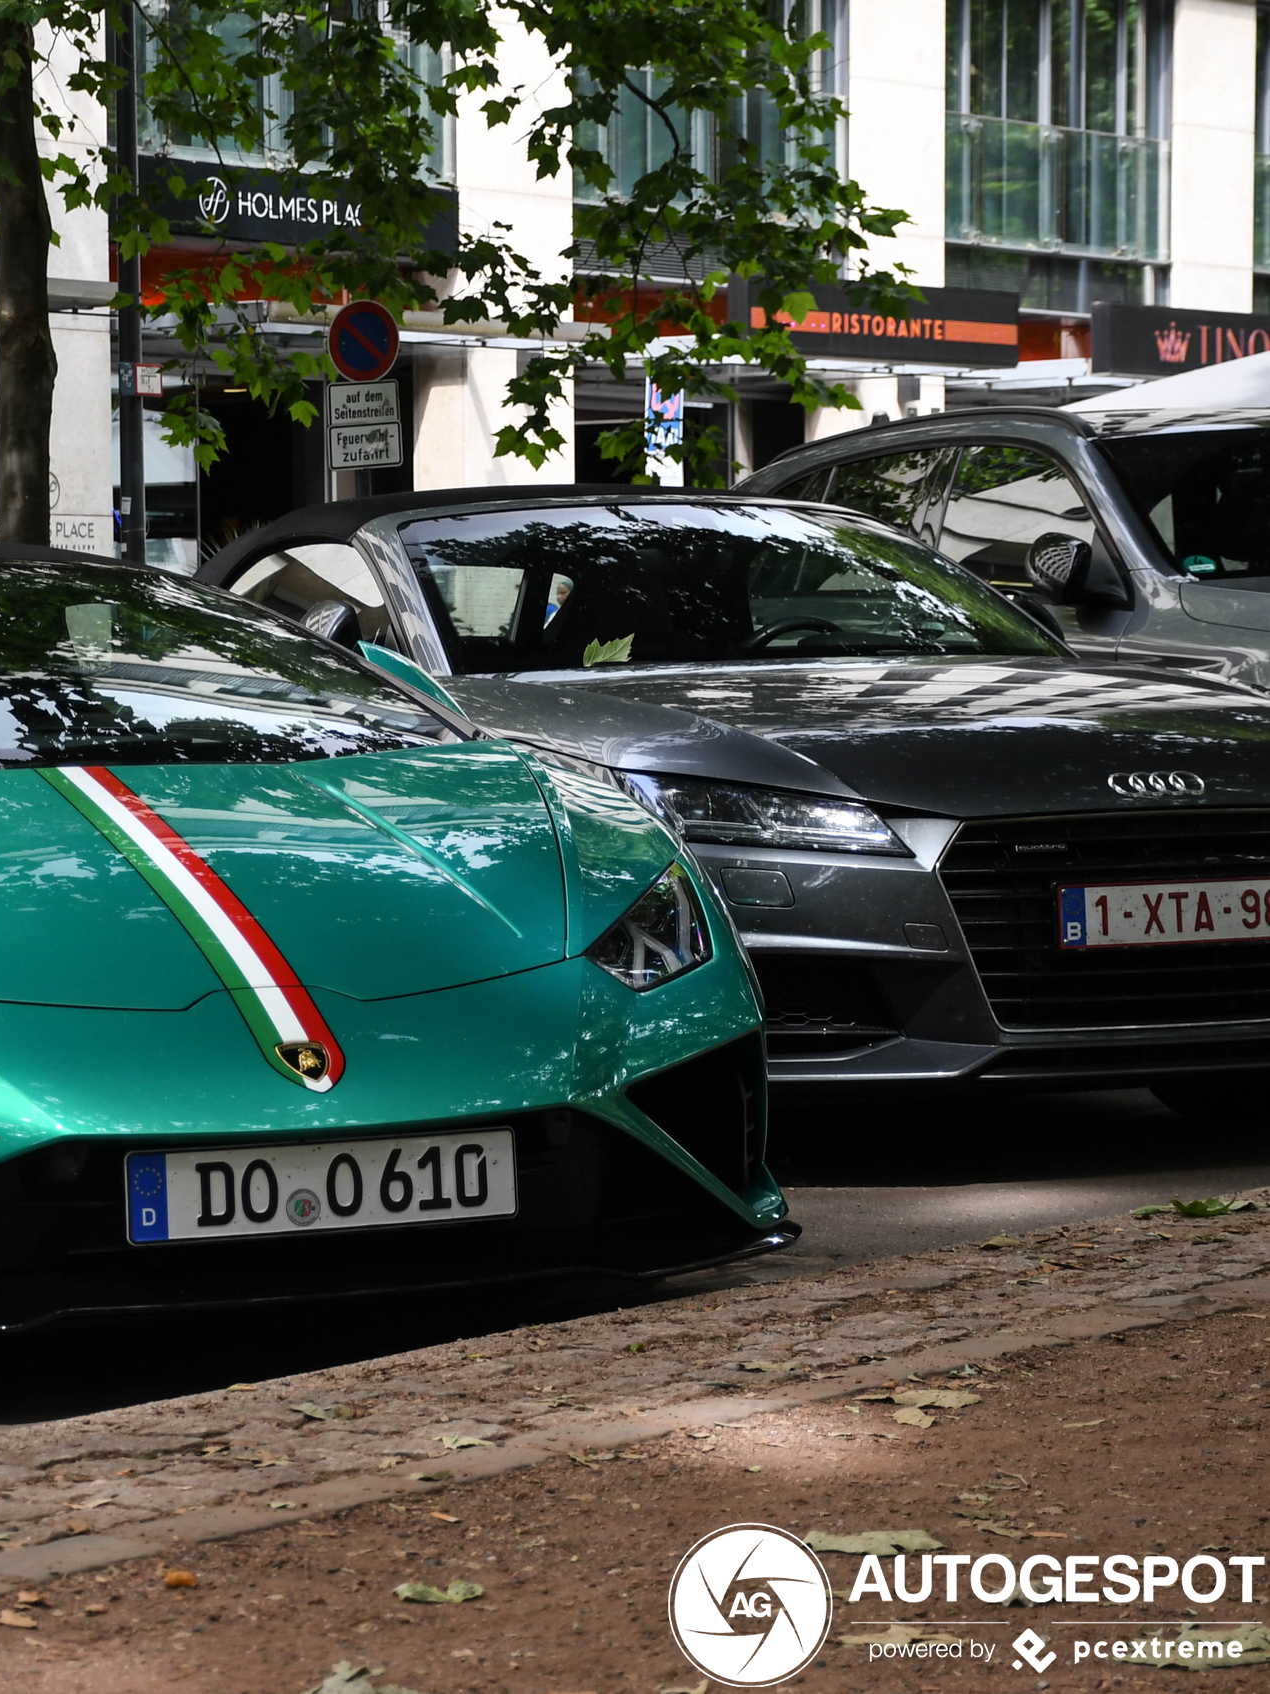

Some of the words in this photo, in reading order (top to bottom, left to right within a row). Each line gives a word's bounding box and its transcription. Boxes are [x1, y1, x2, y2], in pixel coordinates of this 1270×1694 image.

[238, 190, 318, 224] HOLMES
[830, 311, 944, 341] RISTORANTE
[346, 391, 360, 403] auf
[365, 390, 383, 402] dem
[334, 405, 395, 420] Seitenstreifen
[55, 522, 95, 538] PLACE
[1066, 922, 1082, 941] B
[195, 1159, 279, 1227] DO
[379, 1143, 489, 1213] 610
[142, 1207, 156, 1226] D
